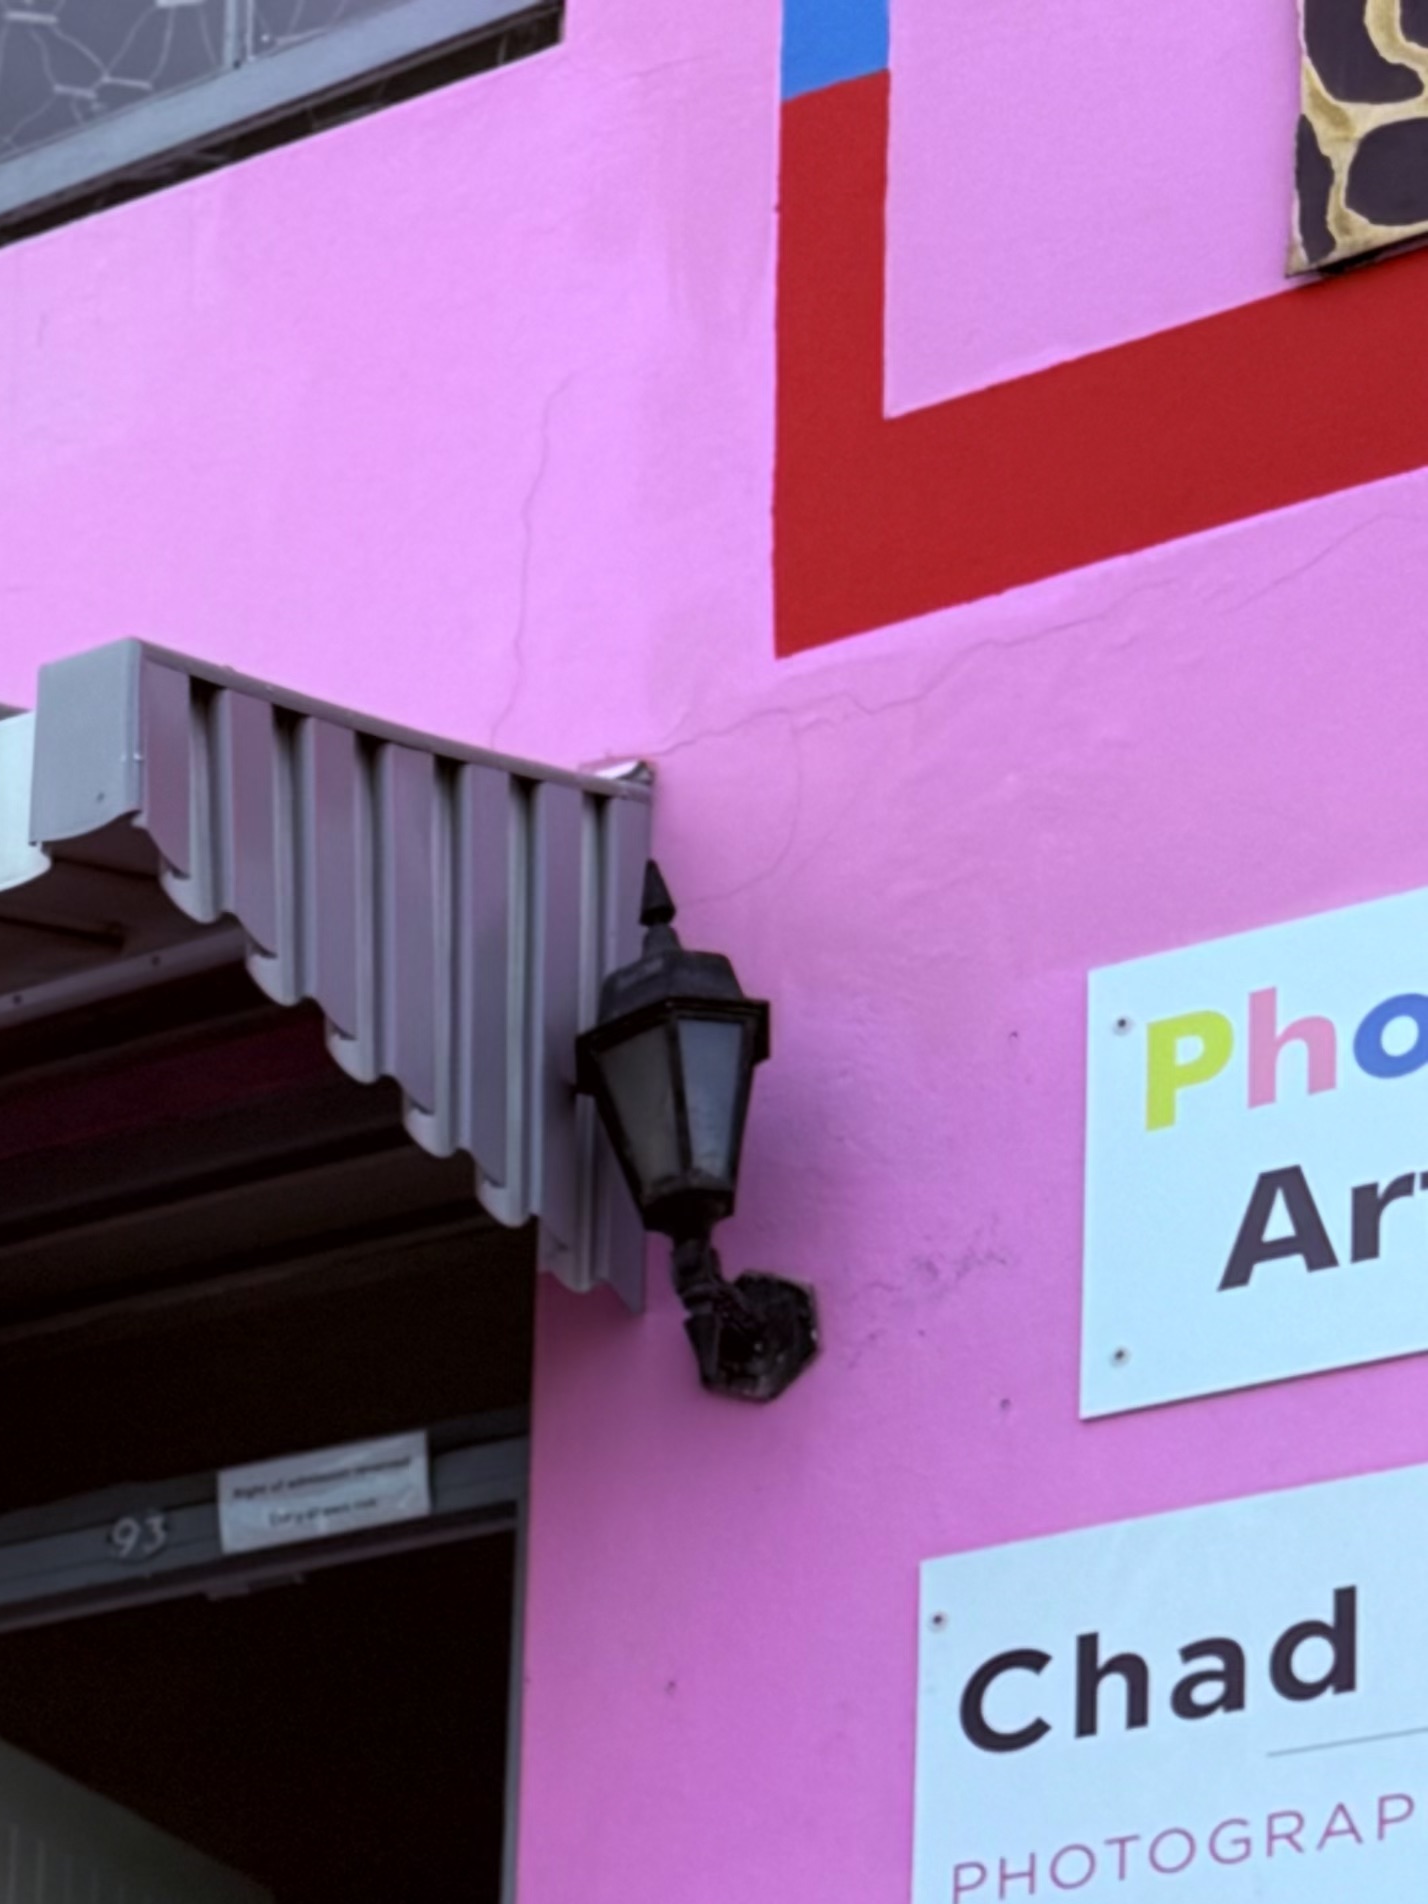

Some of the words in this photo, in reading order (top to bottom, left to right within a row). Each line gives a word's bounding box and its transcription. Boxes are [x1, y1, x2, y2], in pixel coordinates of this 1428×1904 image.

[1215, 1163, 1428, 1293] Ar
[111, 1514, 167, 1558] 93
[957, 1585, 1360, 1755] Chad
